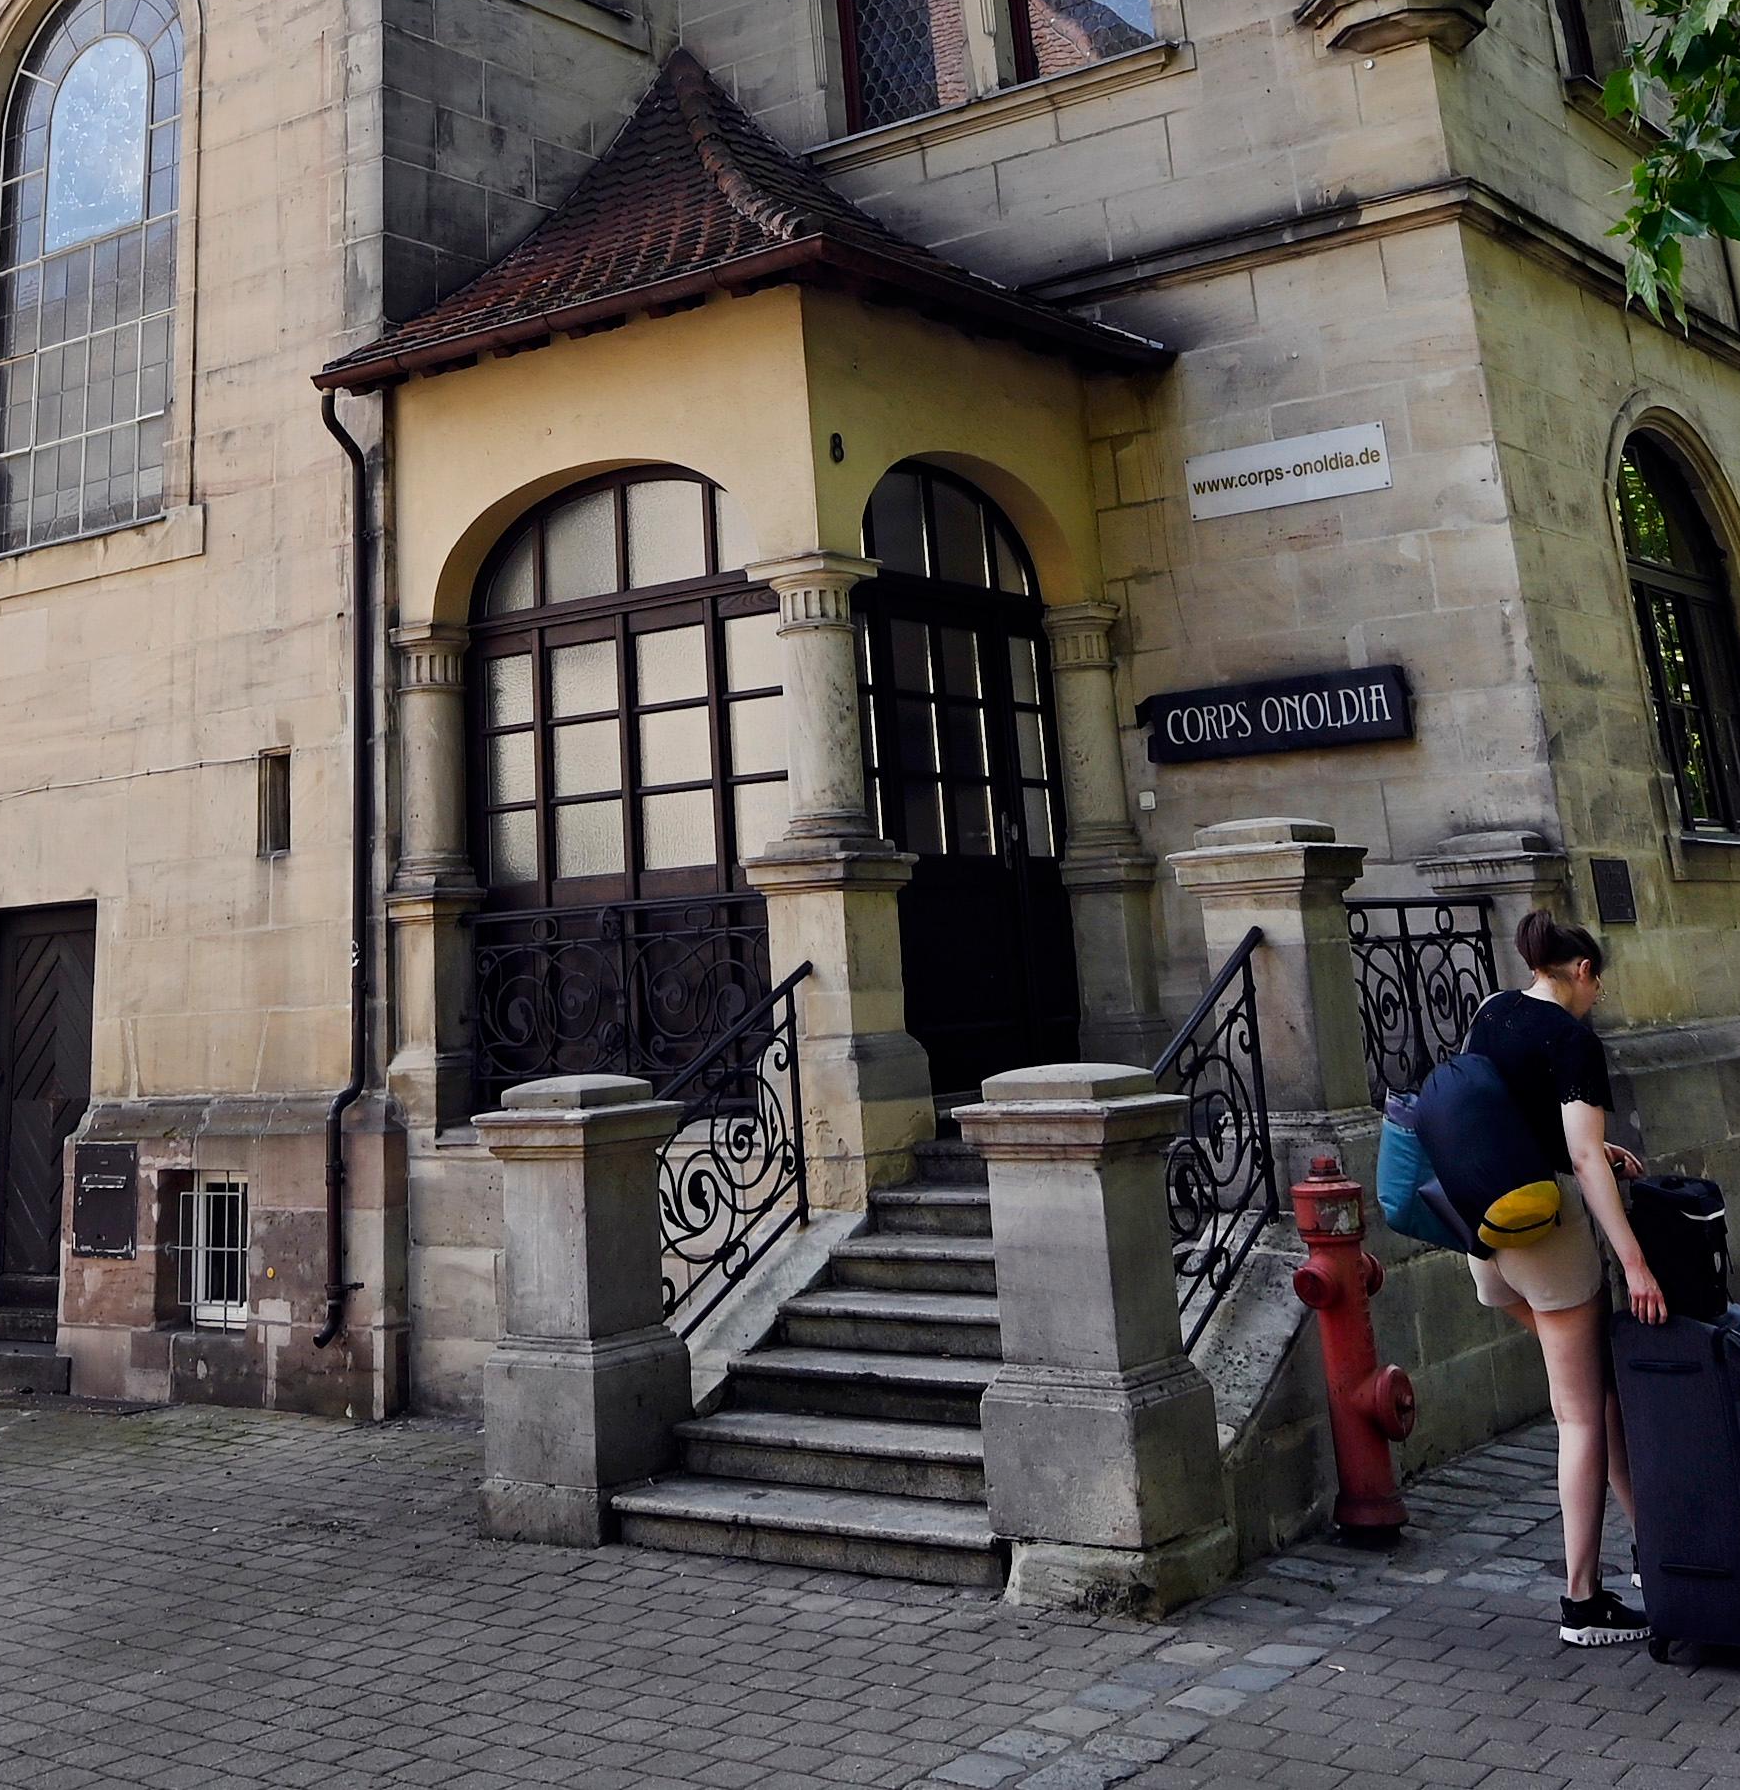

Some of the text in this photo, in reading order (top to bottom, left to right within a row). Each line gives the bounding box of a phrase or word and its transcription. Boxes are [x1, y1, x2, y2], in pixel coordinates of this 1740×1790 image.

[1192, 446, 1381, 496] www.corps-onoldia.de
[1166, 684, 1392, 745] CORPS ONOLDIA
